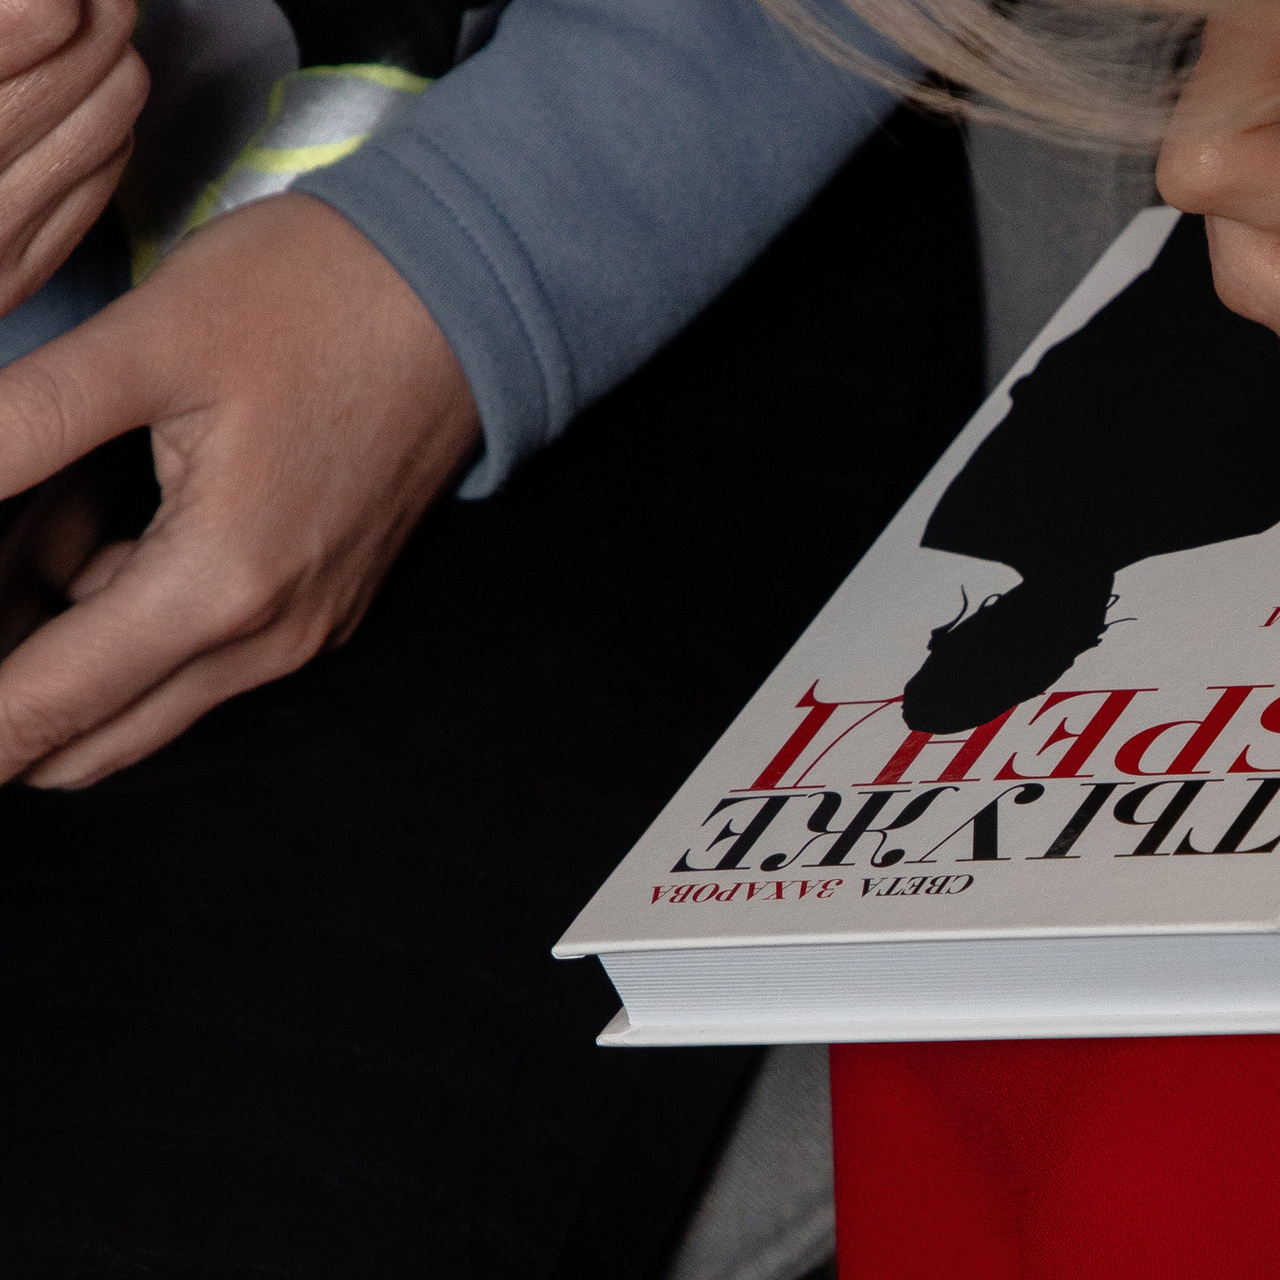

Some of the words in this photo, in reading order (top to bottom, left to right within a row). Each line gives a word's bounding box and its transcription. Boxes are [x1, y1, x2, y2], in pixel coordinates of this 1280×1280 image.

[669, 782, 1046, 874] УЖЕ
[648, 876, 845, 906] ЗАХАРОВА
[859, 872, 975, 898] СВЕТА
